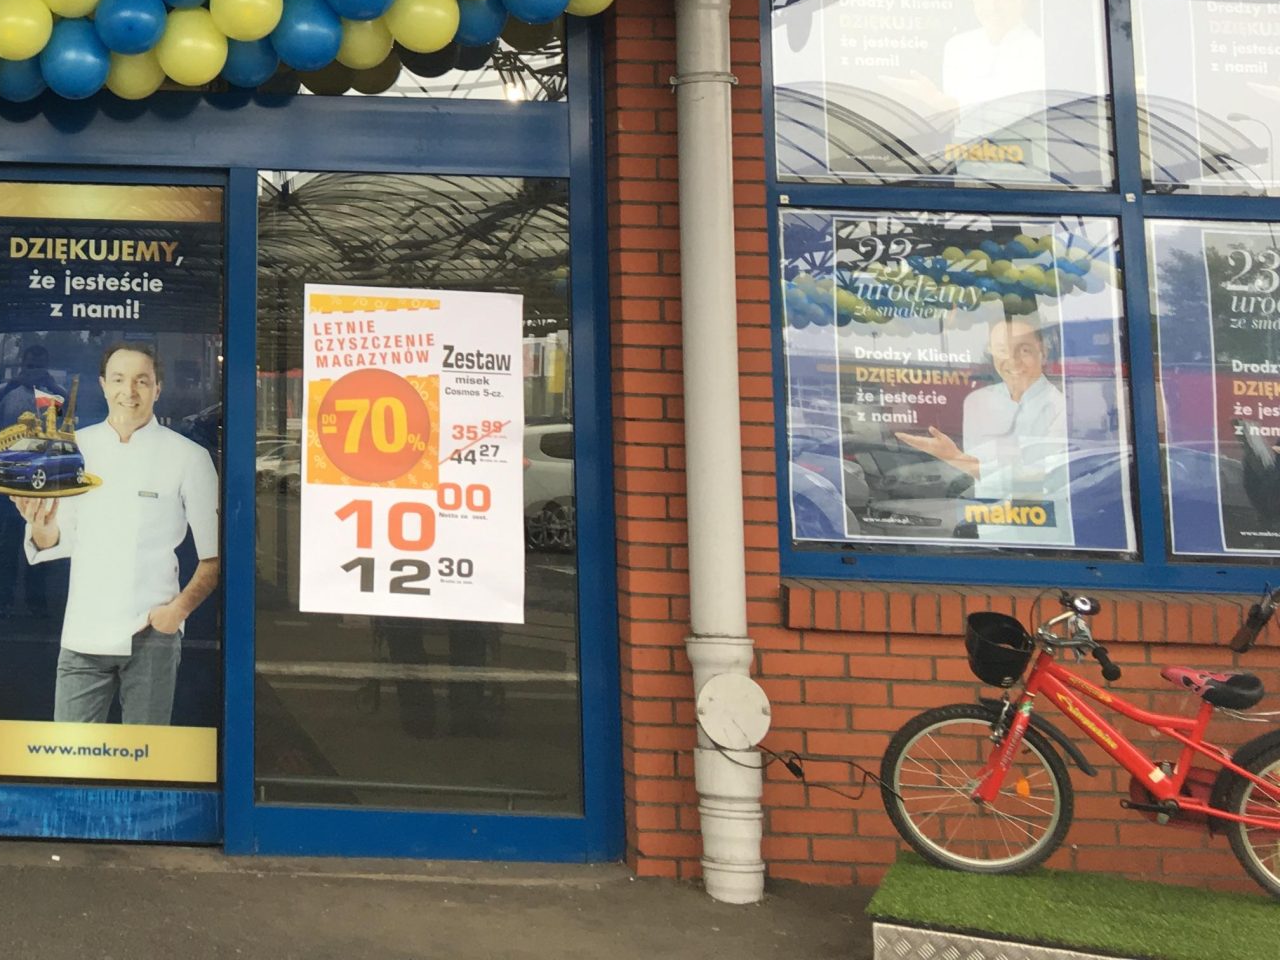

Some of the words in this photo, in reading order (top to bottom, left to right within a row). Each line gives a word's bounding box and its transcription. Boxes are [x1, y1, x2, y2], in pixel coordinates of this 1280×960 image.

[840, 35, 857, 49] że
[864, 35, 929, 51] jesteście
[1210, 40, 1226, 53] że
[840, 55, 850, 66] z
[855, 53, 900, 67] nami!
[1210, 62, 1220, 72] z
[1225, 60, 1268, 73] nami!
[944, 139, 1024, 163] makro
[9, 236, 184, 266] DZIĘKUJEMY,
[853, 237, 912, 281] 23
[1226, 249, 1280, 293] 23
[28, 269, 56, 290] że
[65, 269, 164, 296] jesteście
[856, 275, 984, 311] urodziny
[50, 302, 63, 318] z
[72, 300, 140, 320] nami!
[854, 305, 868, 316] ze
[313, 320, 376, 336] LETNIE
[1230, 317, 1246, 329] ze
[315, 333, 435, 352] CZYSZCZENIE
[316, 347, 430, 369] MAGAZYNÓW
[442, 344, 512, 372] Zestaw
[855, 346, 912, 364] Drodzy
[917, 348, 971, 363] Klienci
[1232, 359, 1280, 374] Drodz
[455, 375, 490, 386] misek
[856, 367, 977, 388] DZIĘKUJEMY,
[445, 385, 480, 397] Cosmos
[856, 388, 874, 402] że
[880, 389, 947, 406] jesteście
[857, 412, 866, 422] z
[872, 410, 918, 424] nami!
[1233, 401, 1252, 416] że
[322, 414, 336, 425] DO
[452, 424, 478, 440] 35
[1234, 425, 1244, 435] z
[450, 449, 477, 465] 44
[479, 444, 500, 457] 27
[334, 499, 436, 552] 10
[437, 482, 491, 513] 00
[965, 501, 1047, 525] makro
[340, 556, 431, 596] 12
[438, 557, 474, 578] 30
[27, 743, 149, 761] www.makro.pl
